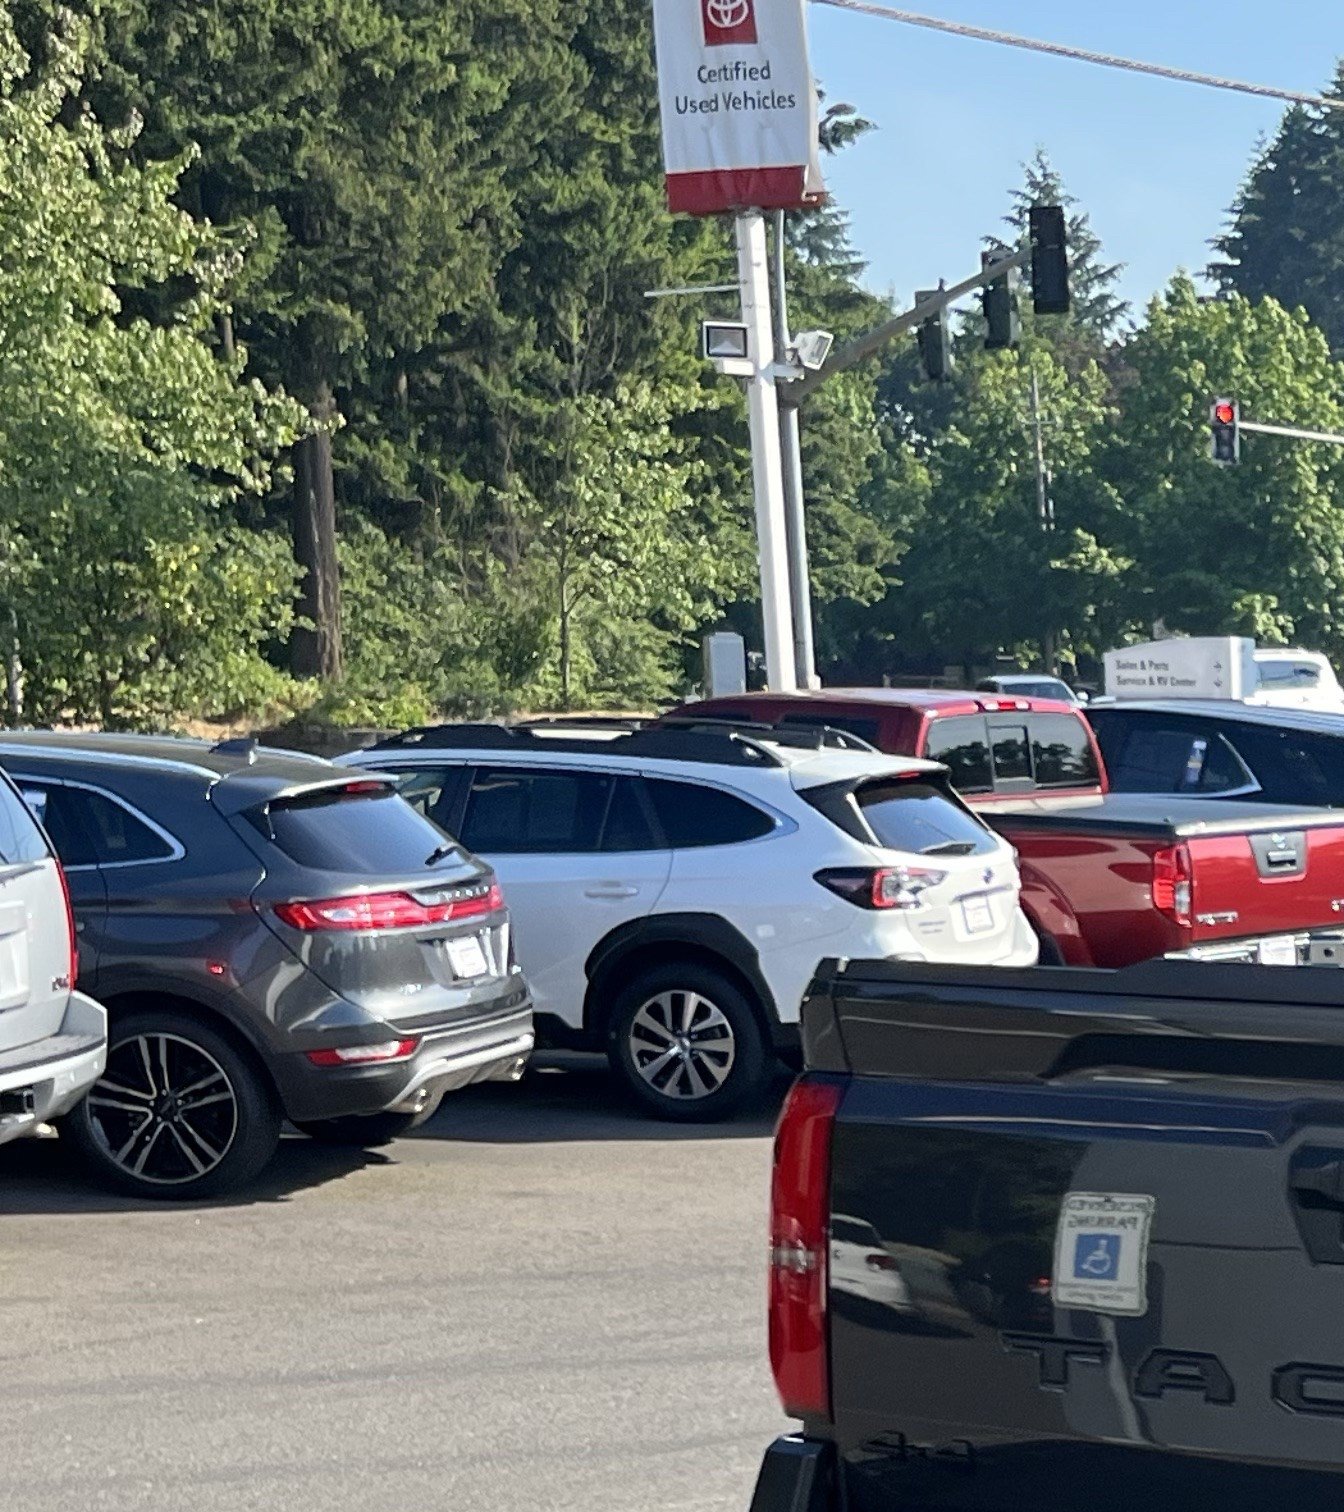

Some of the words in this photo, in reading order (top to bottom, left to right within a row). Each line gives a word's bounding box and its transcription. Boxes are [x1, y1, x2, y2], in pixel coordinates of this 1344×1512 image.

[697, 60, 771, 84] Certified
[675, 93, 719, 115] Used
[721, 88, 796, 111] Vehicles
